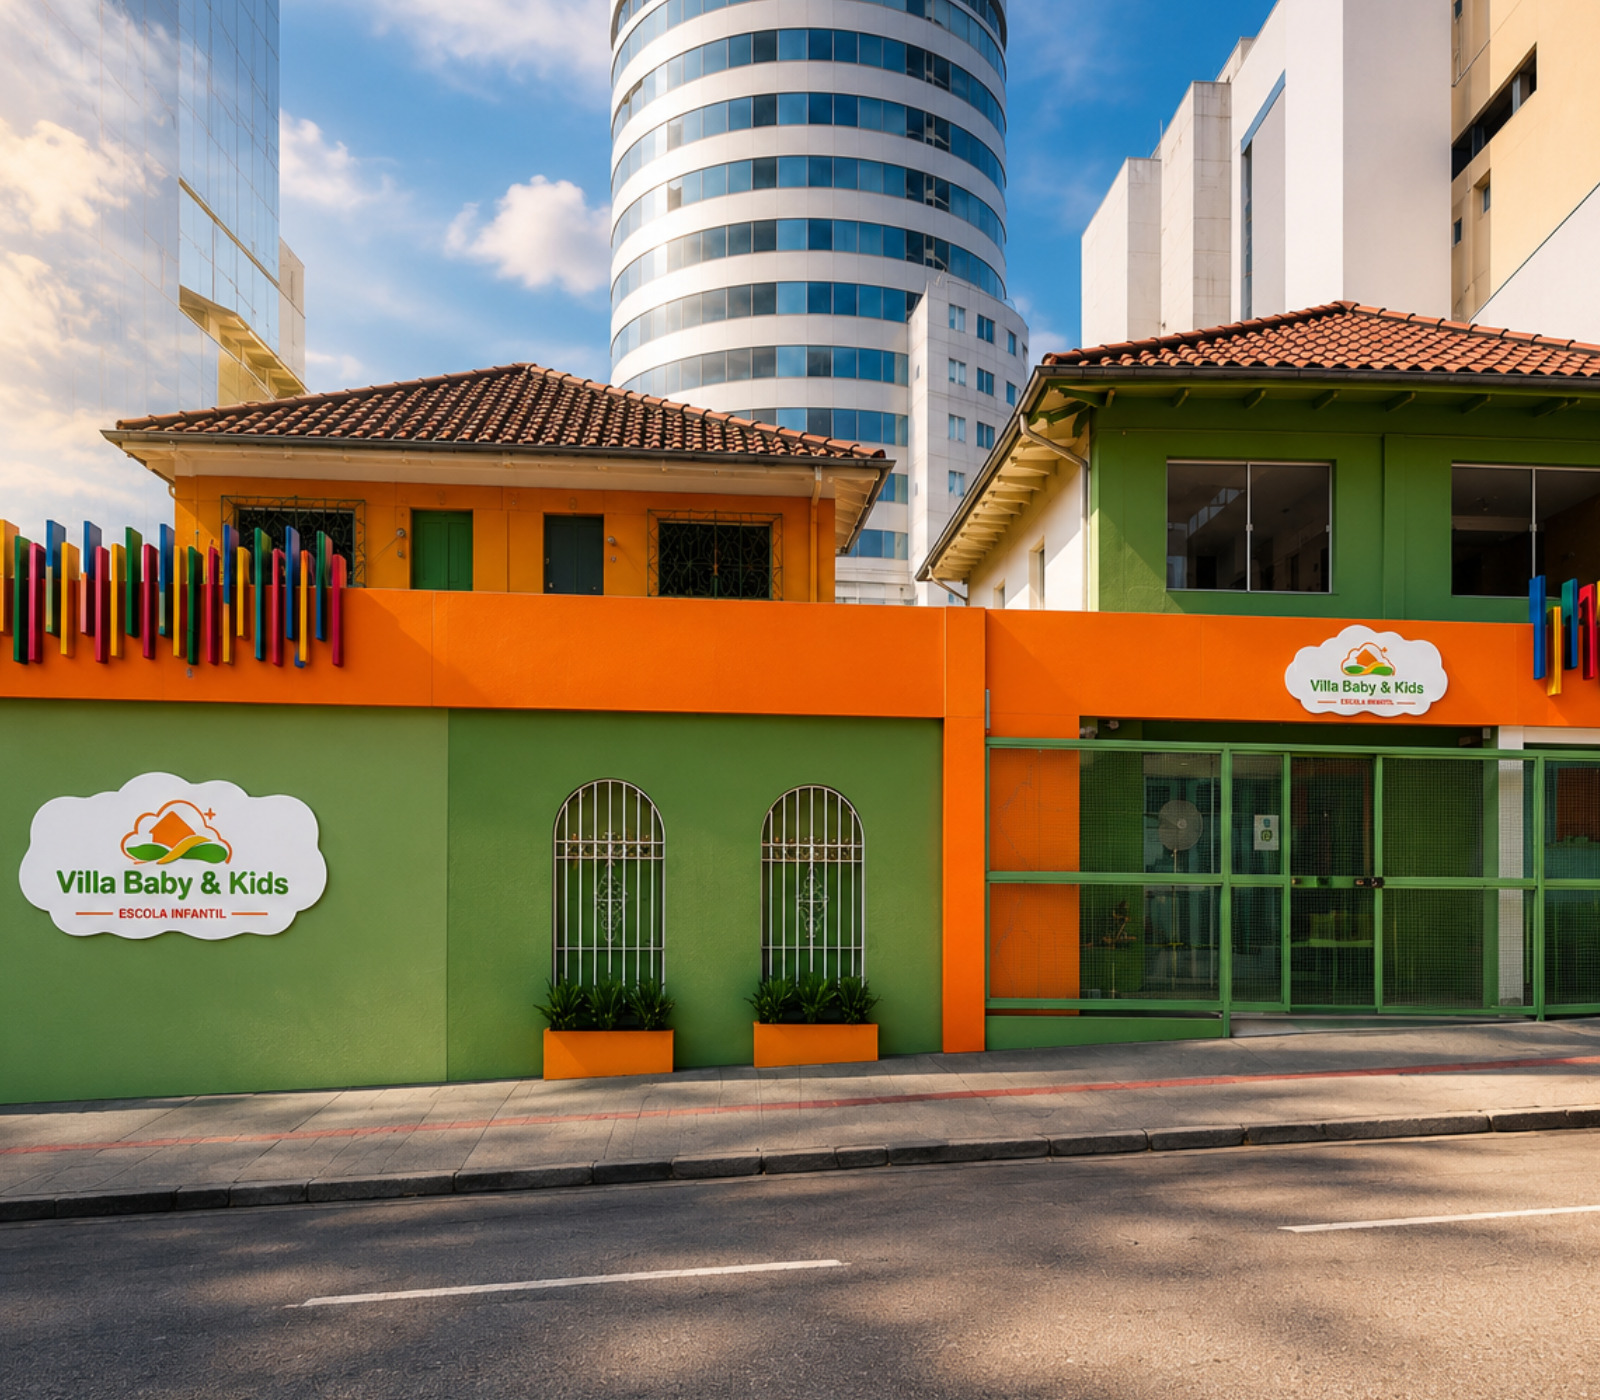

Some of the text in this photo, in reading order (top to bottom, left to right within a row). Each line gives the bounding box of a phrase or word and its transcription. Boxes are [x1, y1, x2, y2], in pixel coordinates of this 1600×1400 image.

[1310, 679, 1424, 696] Villa Baby & Kids
[56, 870, 289, 900] Villa Baby & Kids
[118, 908, 227, 919] ESCOLA INFANTIL
